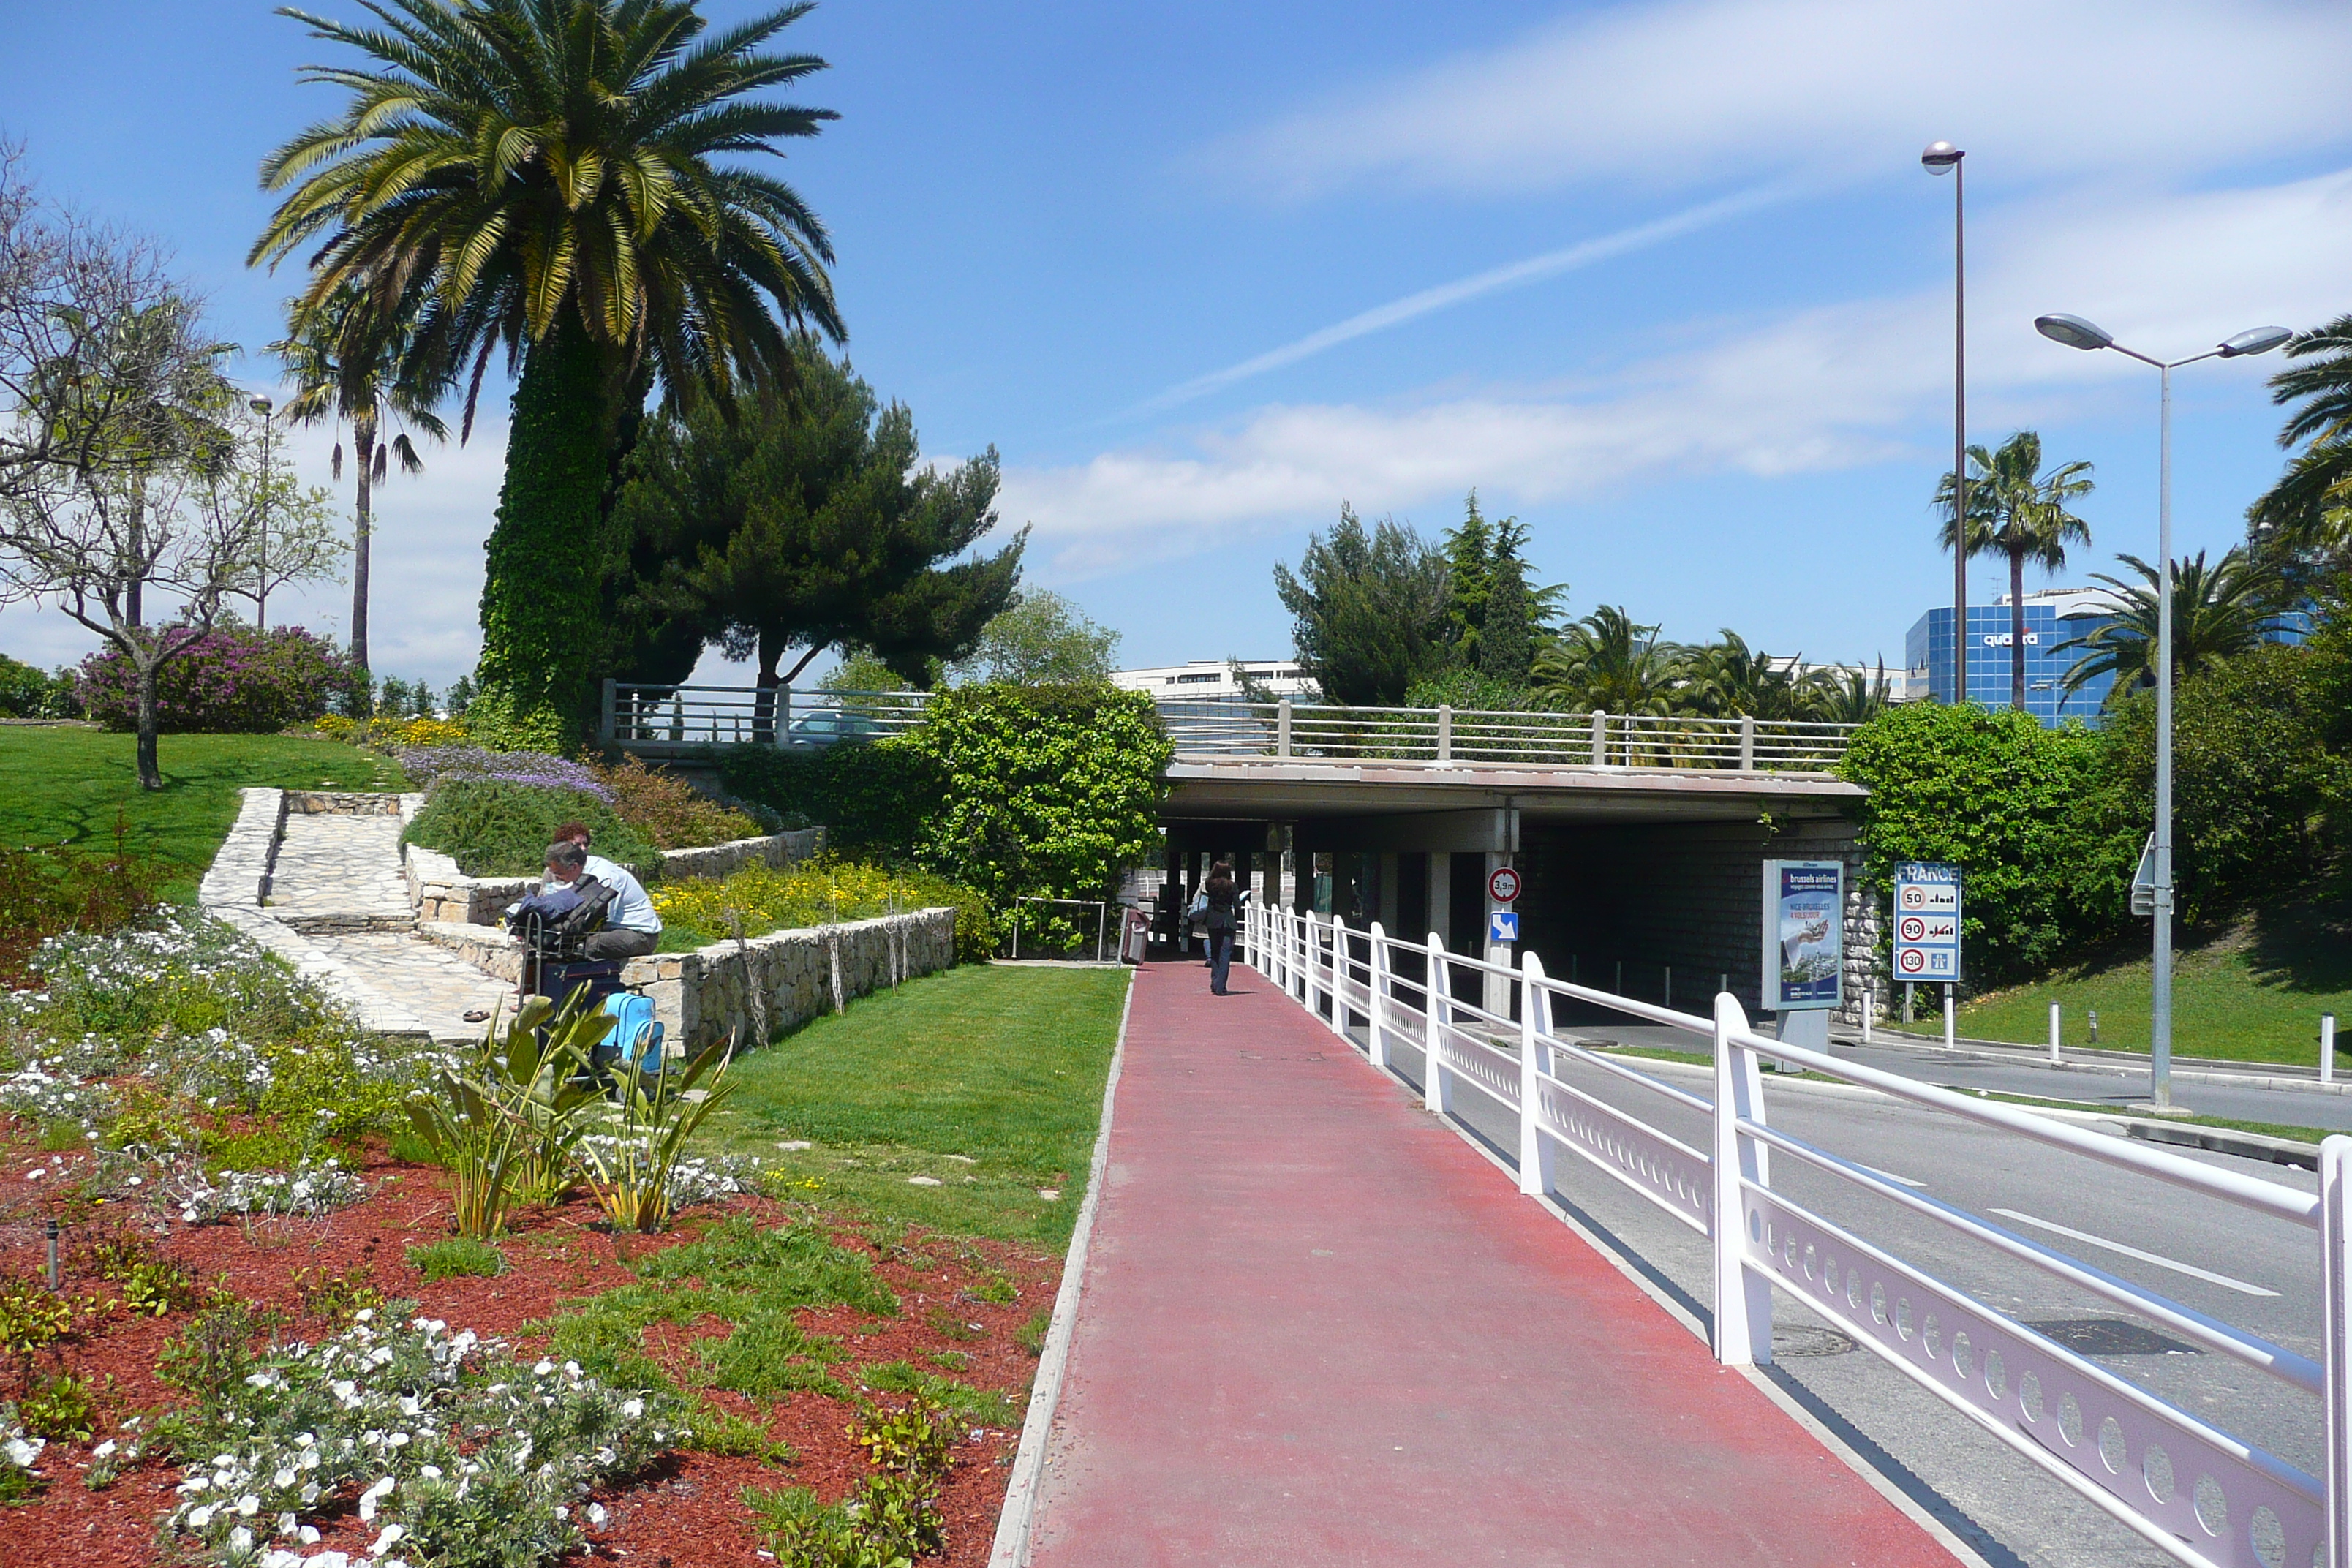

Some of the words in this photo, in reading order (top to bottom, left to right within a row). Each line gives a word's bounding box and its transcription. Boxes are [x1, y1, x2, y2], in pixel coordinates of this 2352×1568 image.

[1984, 633, 2038, 647] quara
[1790, 873, 1814, 883] brussels
[1815, 874, 1836, 883] airlines
[1897, 866, 1959, 882] FRANCE
[1906, 894, 1921, 903] 50
[1905, 924, 1921, 934] 90
[1904, 956, 1921, 965] 130
